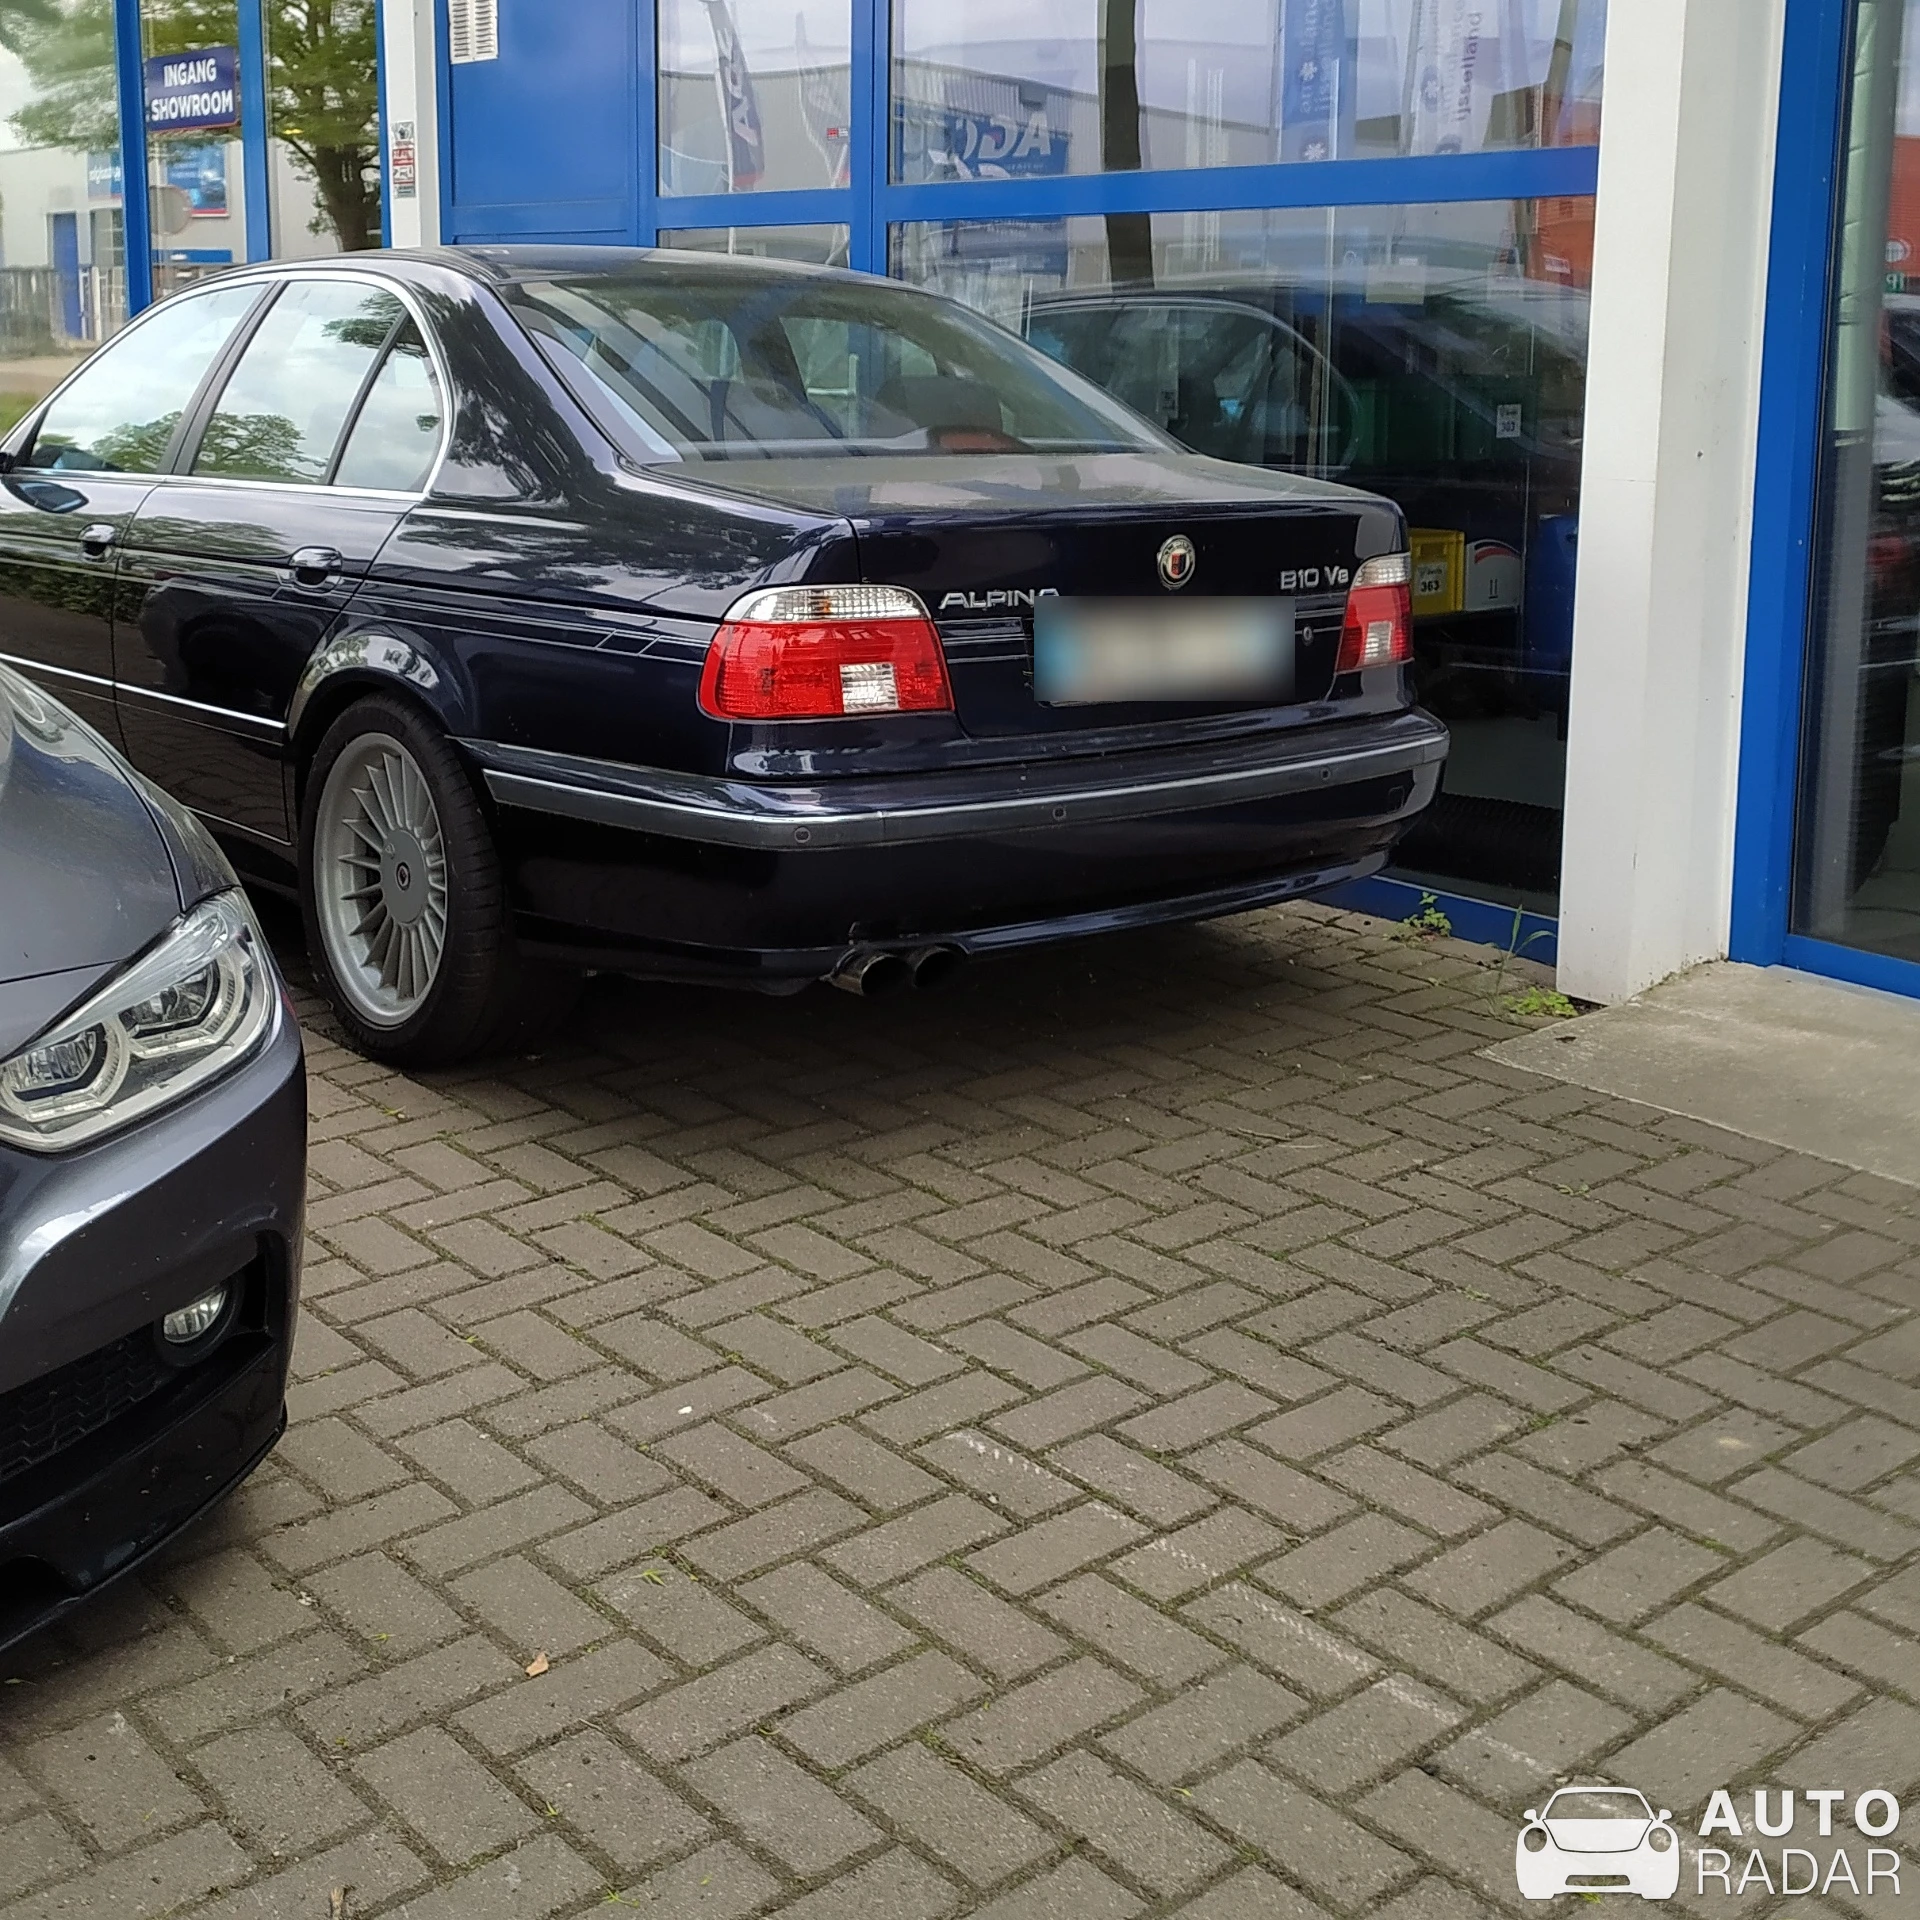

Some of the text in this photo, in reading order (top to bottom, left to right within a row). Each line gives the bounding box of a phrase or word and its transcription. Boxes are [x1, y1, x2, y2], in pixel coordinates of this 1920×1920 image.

[163, 58, 217, 88] INGANG
[151, 89, 234, 121] SHOWROOM
[1280, 565, 1349, 590] B10 V8
[1420, 580, 1440, 593] 363
